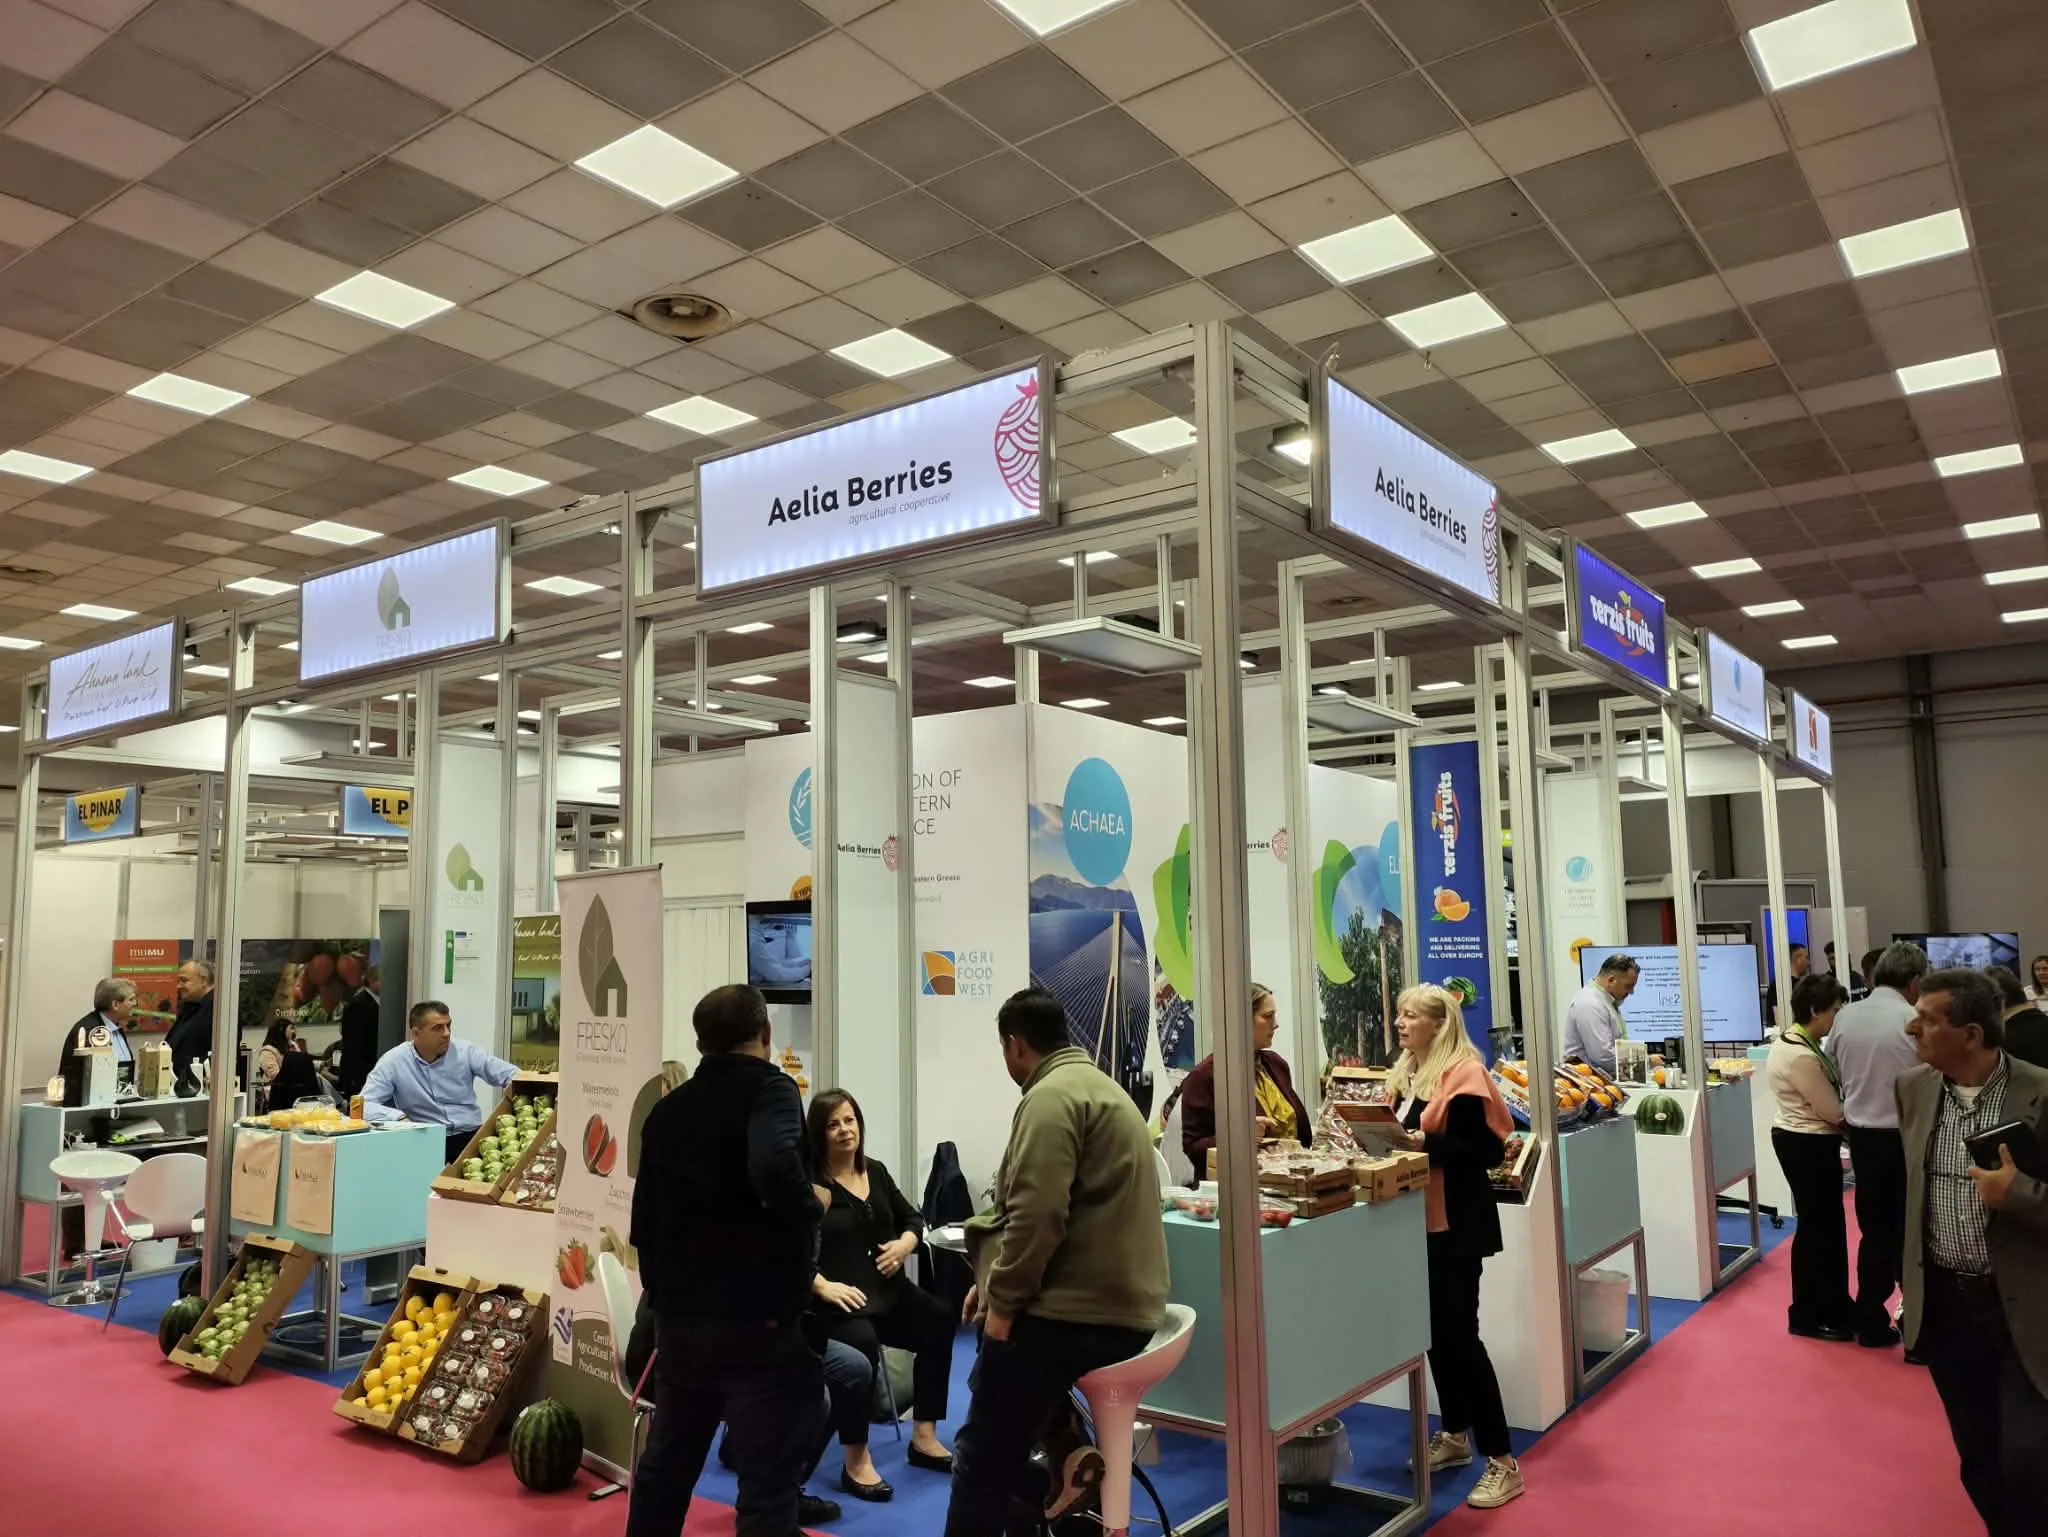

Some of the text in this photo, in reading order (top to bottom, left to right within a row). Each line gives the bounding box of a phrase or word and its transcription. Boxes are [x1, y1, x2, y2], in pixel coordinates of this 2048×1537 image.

[767, 460, 953, 526] Aelia Berries
[848, 492, 951, 526] agricultural cooperative
[1375, 466, 1415, 514] Aelia
[1419, 492, 1467, 544] Berries
[1589, 595, 1655, 654] terzis fruits
[939, 769, 962, 787] OF
[78, 798, 122, 820] EL PINAR
[371, 798, 391, 815] EL
[1070, 809, 1125, 835] ACHAEA
[1437, 771, 1456, 877] terzis fruits
[837, 843, 881, 855] Aelia Berries
[957, 951, 993, 964] AGRI
[957, 967, 993, 980] FOOD
[958, 983, 993, 997] WEST
